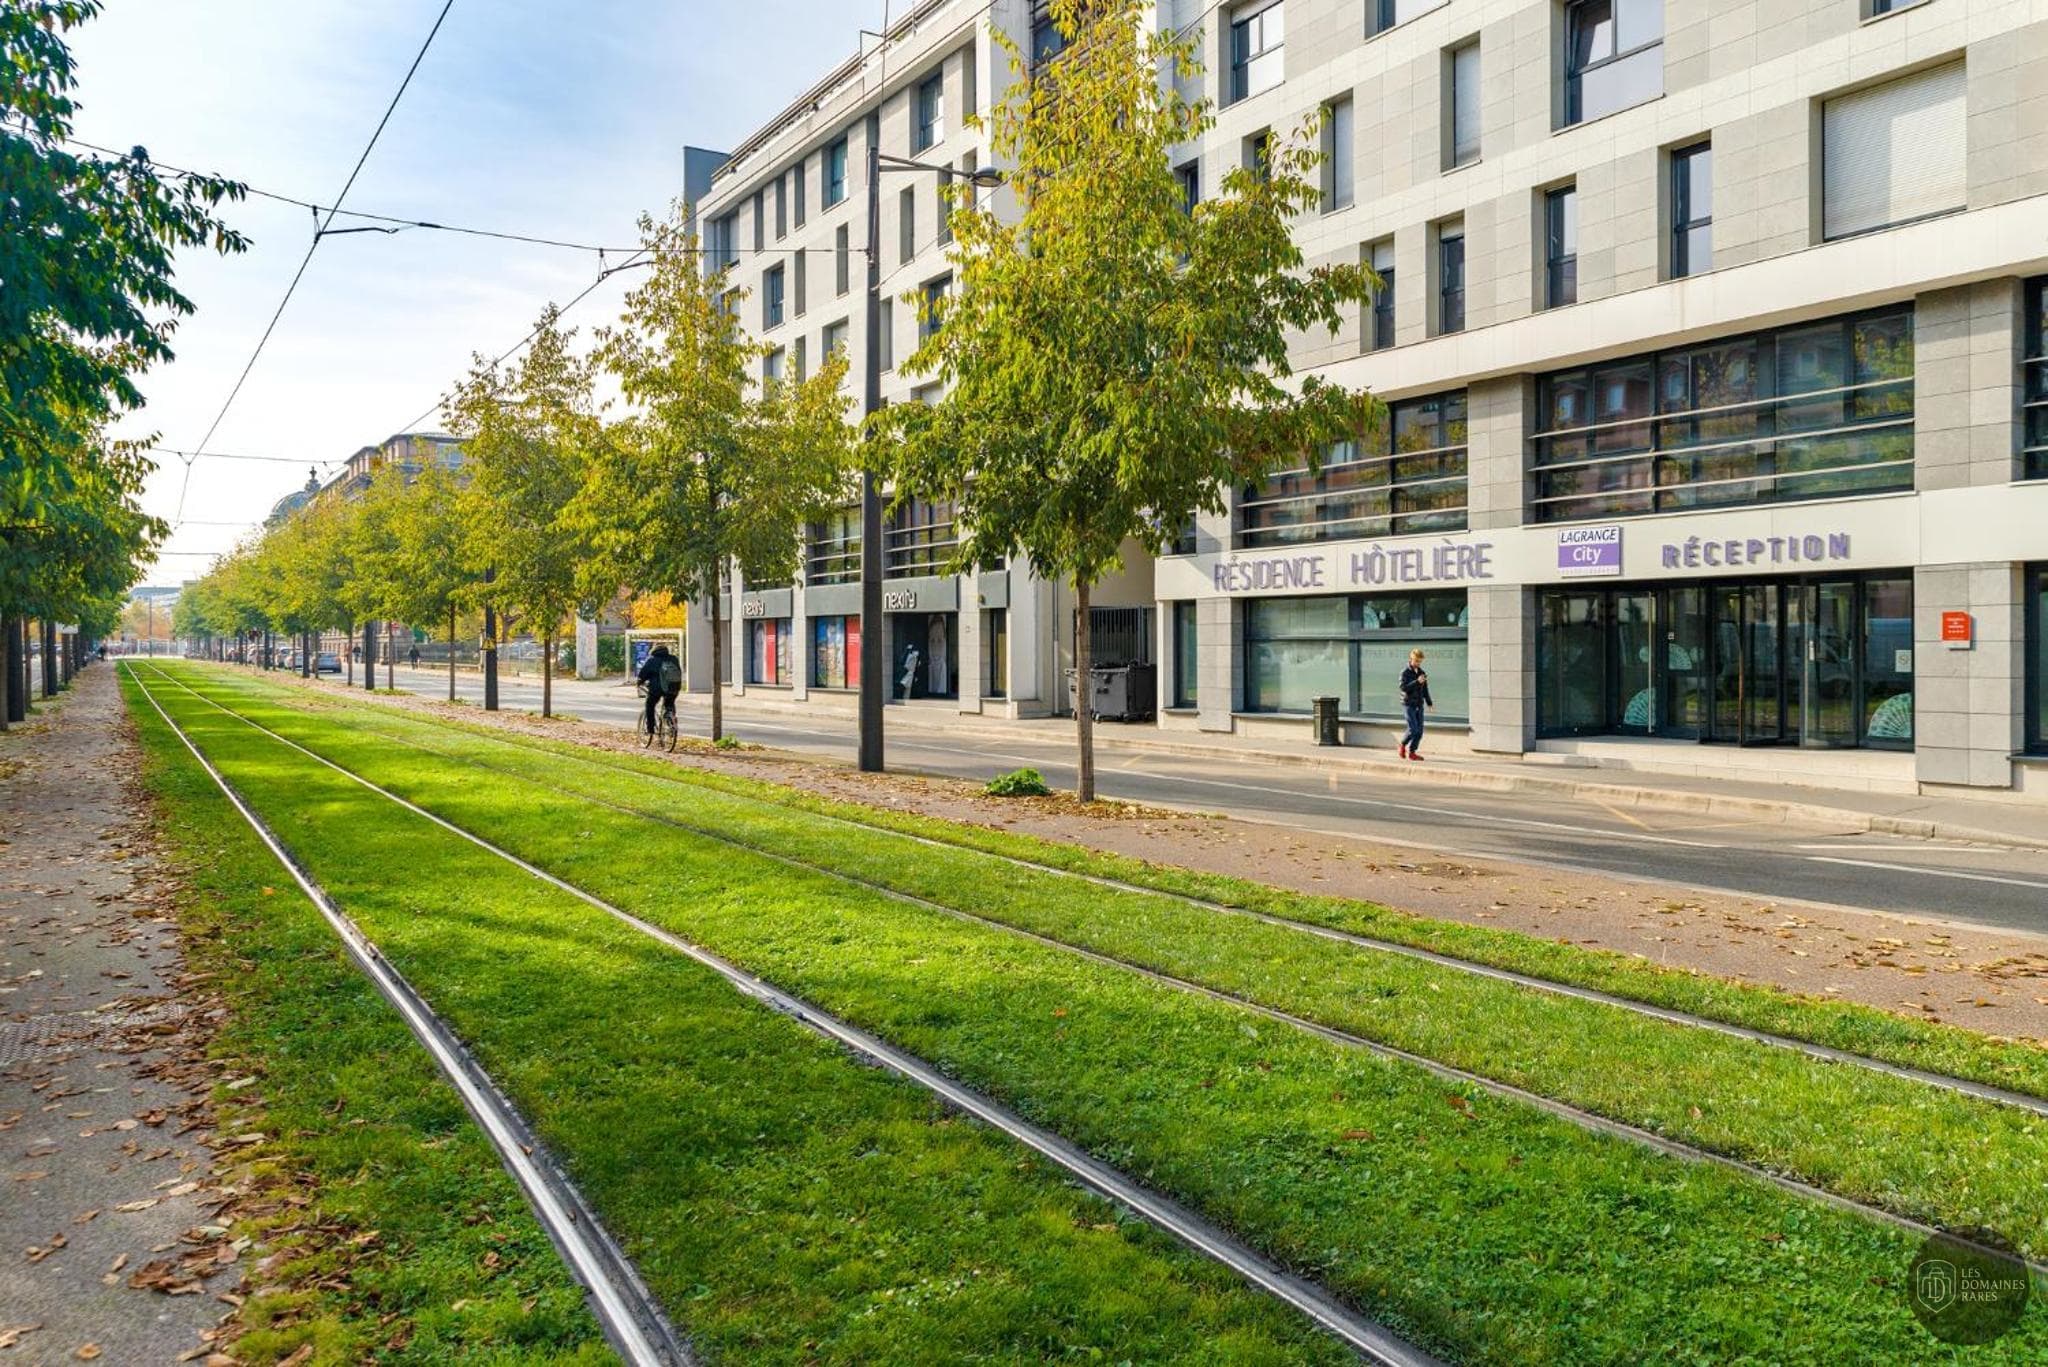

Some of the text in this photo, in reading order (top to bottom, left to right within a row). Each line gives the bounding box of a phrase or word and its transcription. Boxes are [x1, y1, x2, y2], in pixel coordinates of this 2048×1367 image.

[1560, 529, 1617, 543] LAGRANGE
[1662, 533, 1852, 569] RÉCEPTION
[1214, 538, 1494, 592] RÉSIDENCE HÔTELIÈRE
